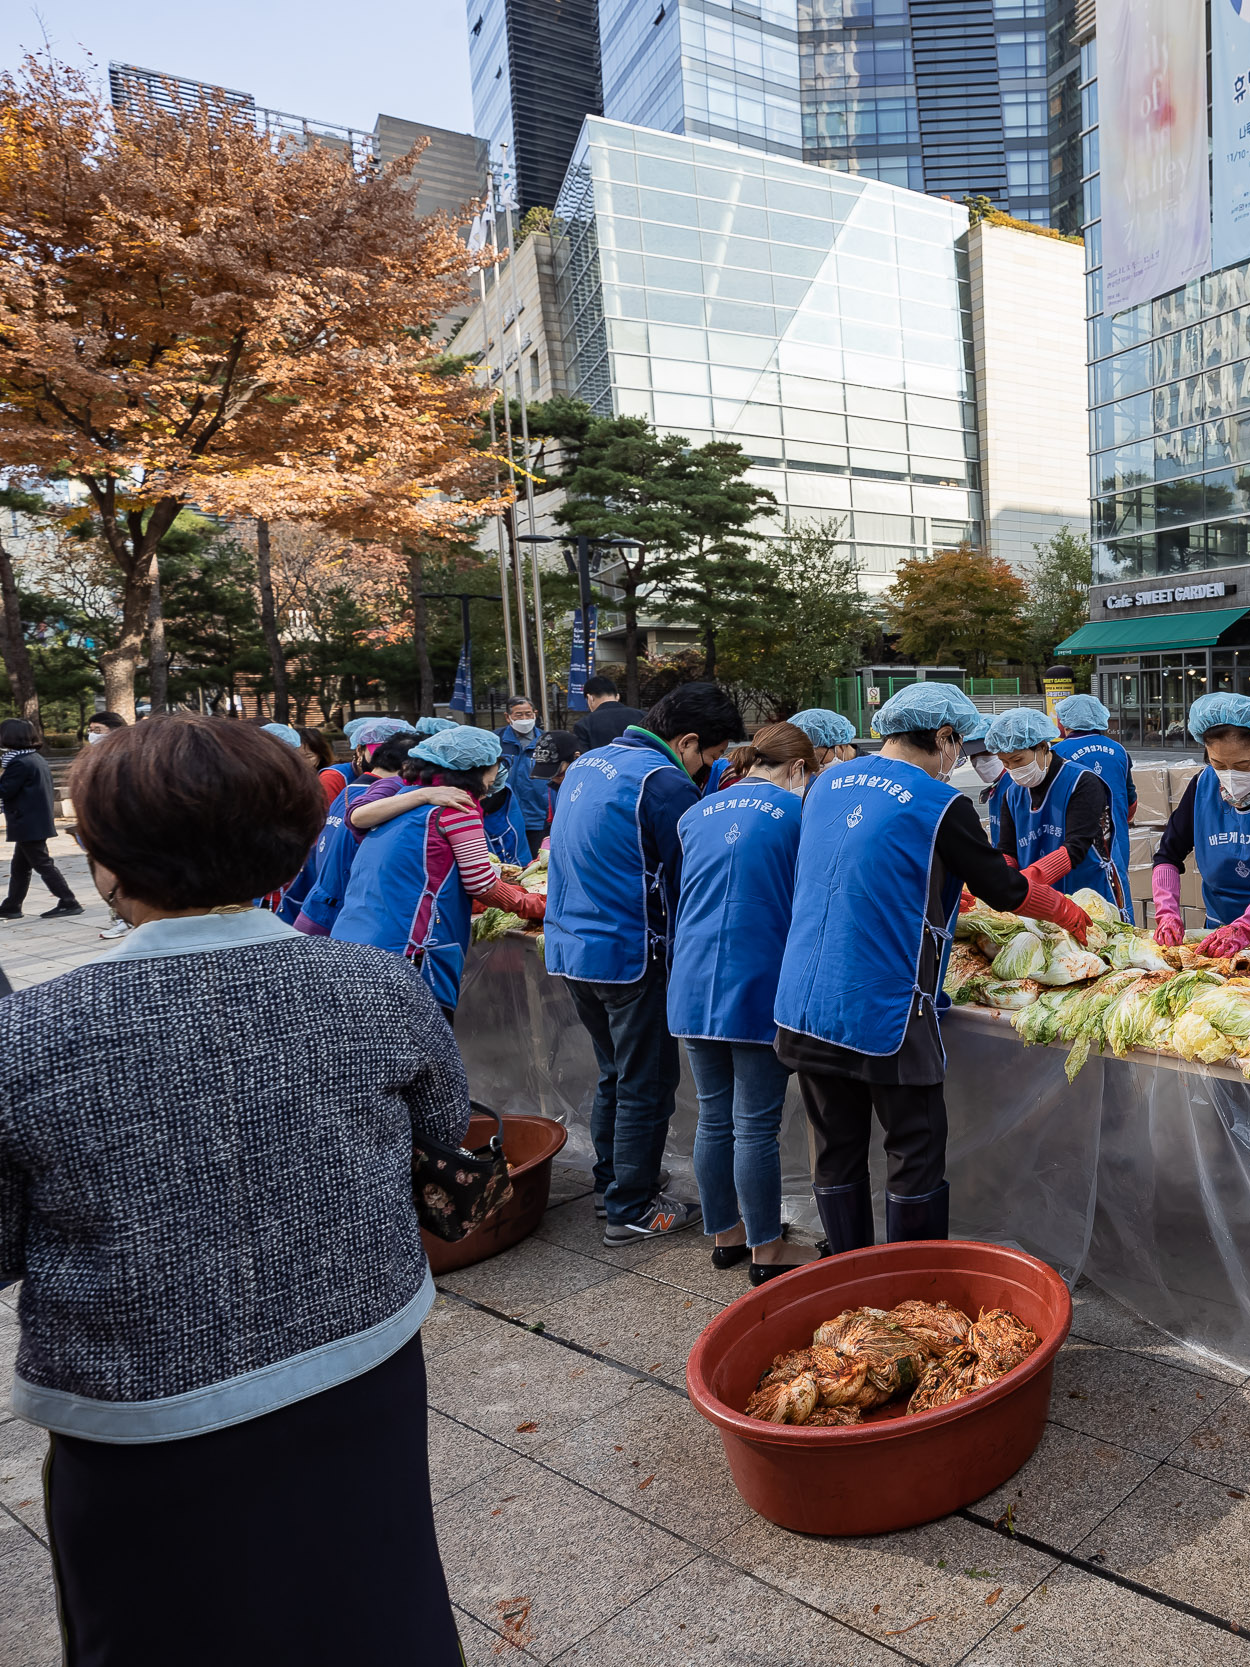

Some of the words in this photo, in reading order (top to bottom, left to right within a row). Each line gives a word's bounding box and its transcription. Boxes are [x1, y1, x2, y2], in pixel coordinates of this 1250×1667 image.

[1106, 594, 1133, 609] Cafe
[1135, 589, 1174, 606] SWEET
[1174, 582, 1225, 601] GARDEN
[831, 774, 913, 804] 바르게살기운동
[702, 798, 786, 820] 바르게살기운동
[1018, 824, 1063, 848] 바게기운동
[649, 1212, 676, 1231] N
